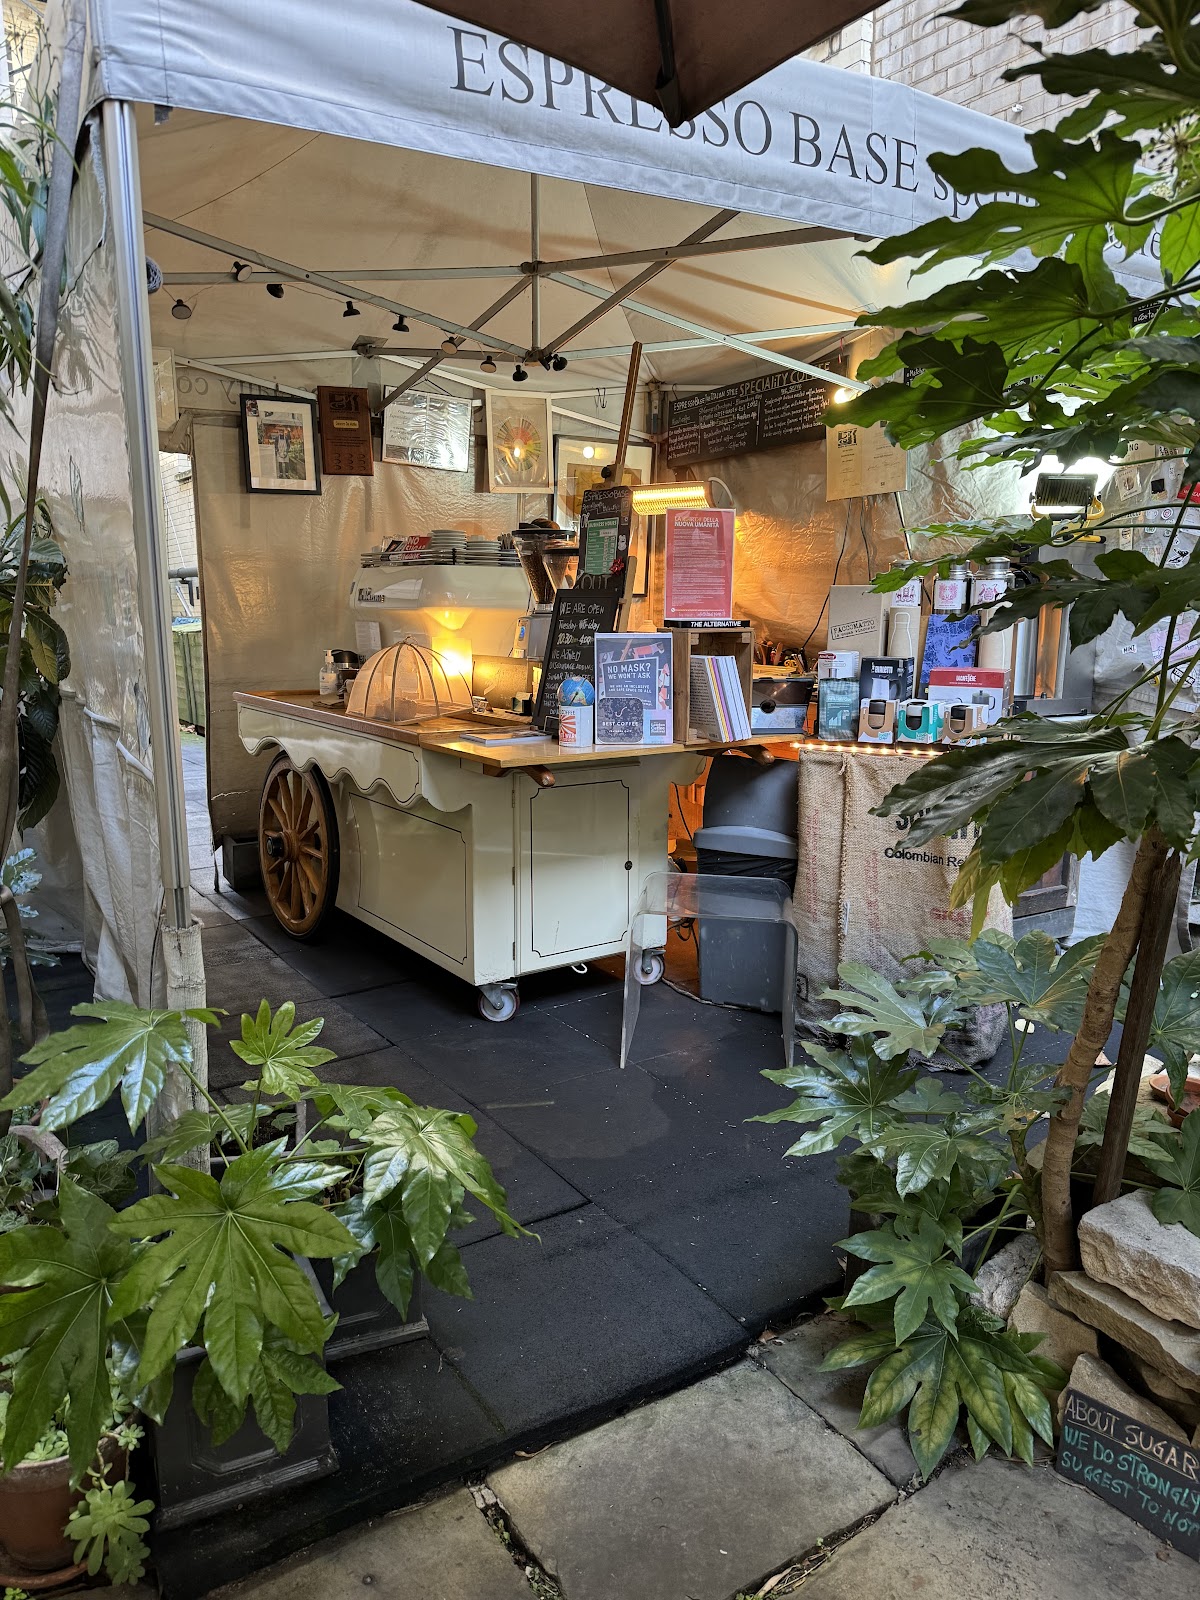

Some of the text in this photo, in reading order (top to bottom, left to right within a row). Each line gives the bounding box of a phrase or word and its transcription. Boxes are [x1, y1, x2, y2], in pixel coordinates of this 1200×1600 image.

[447, 25, 920, 193] ESPRSO BASE
[739, 371, 789, 397] SPECIALITY
[408, 536, 420, 545] NO
[560, 602, 605, 615] WE ARE OPEN
[546, 672, 563, 680] SUGAR
[607, 662, 651, 673] NO MASK?
[884, 847, 966, 868] Colombian Re
[1065, 1394, 1200, 1483] ABOUT SUGAR
[1064, 1425, 1200, 1516] WE DO STRONGLY
[1061, 1451, 1134, 1499] SUGGEST
[1138, 1490, 1160, 1514] TO
